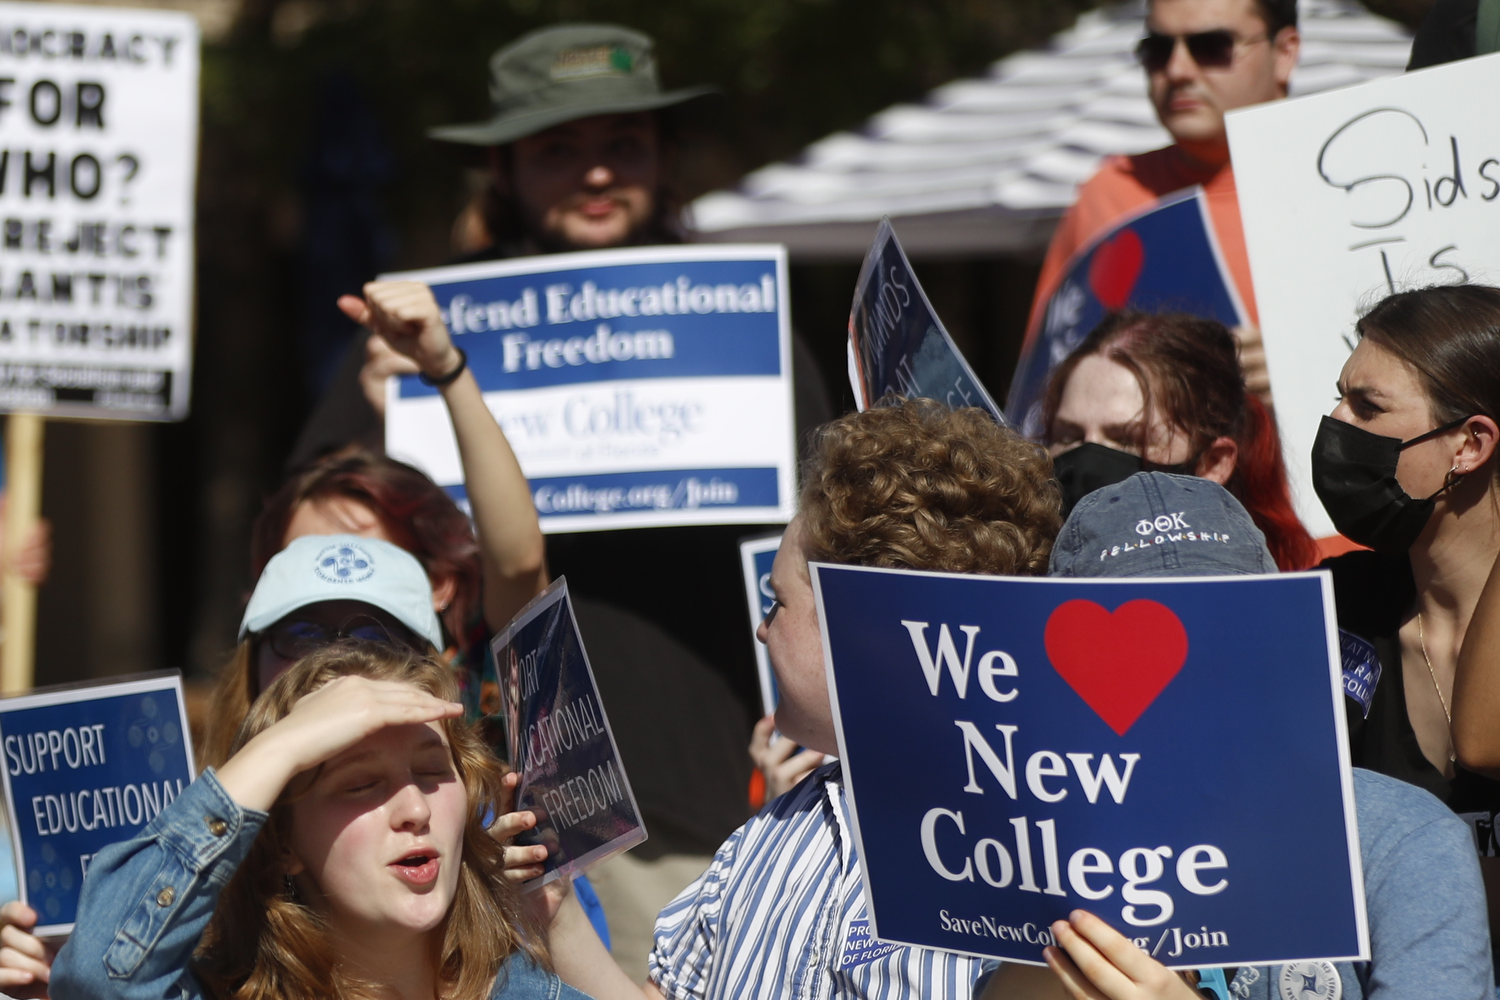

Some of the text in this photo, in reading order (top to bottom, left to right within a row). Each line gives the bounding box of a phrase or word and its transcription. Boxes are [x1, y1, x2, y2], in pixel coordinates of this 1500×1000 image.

[4, 219, 173, 258] REJECT
[442, 274, 776, 334] fend Educational
[503, 323, 674, 373] Freedom
[564, 388, 704, 447] College
[534, 478, 738, 516] College.org/Join
[901, 620, 1019, 702] We
[5, 724, 106, 776] SUPPORT
[955, 721, 1140, 804] New
[542, 760, 623, 834] FREEDOM
[920, 808, 1229, 926] College
[842, 944, 899, 965] OF FLORI
[846, 939, 875, 951] NEW
